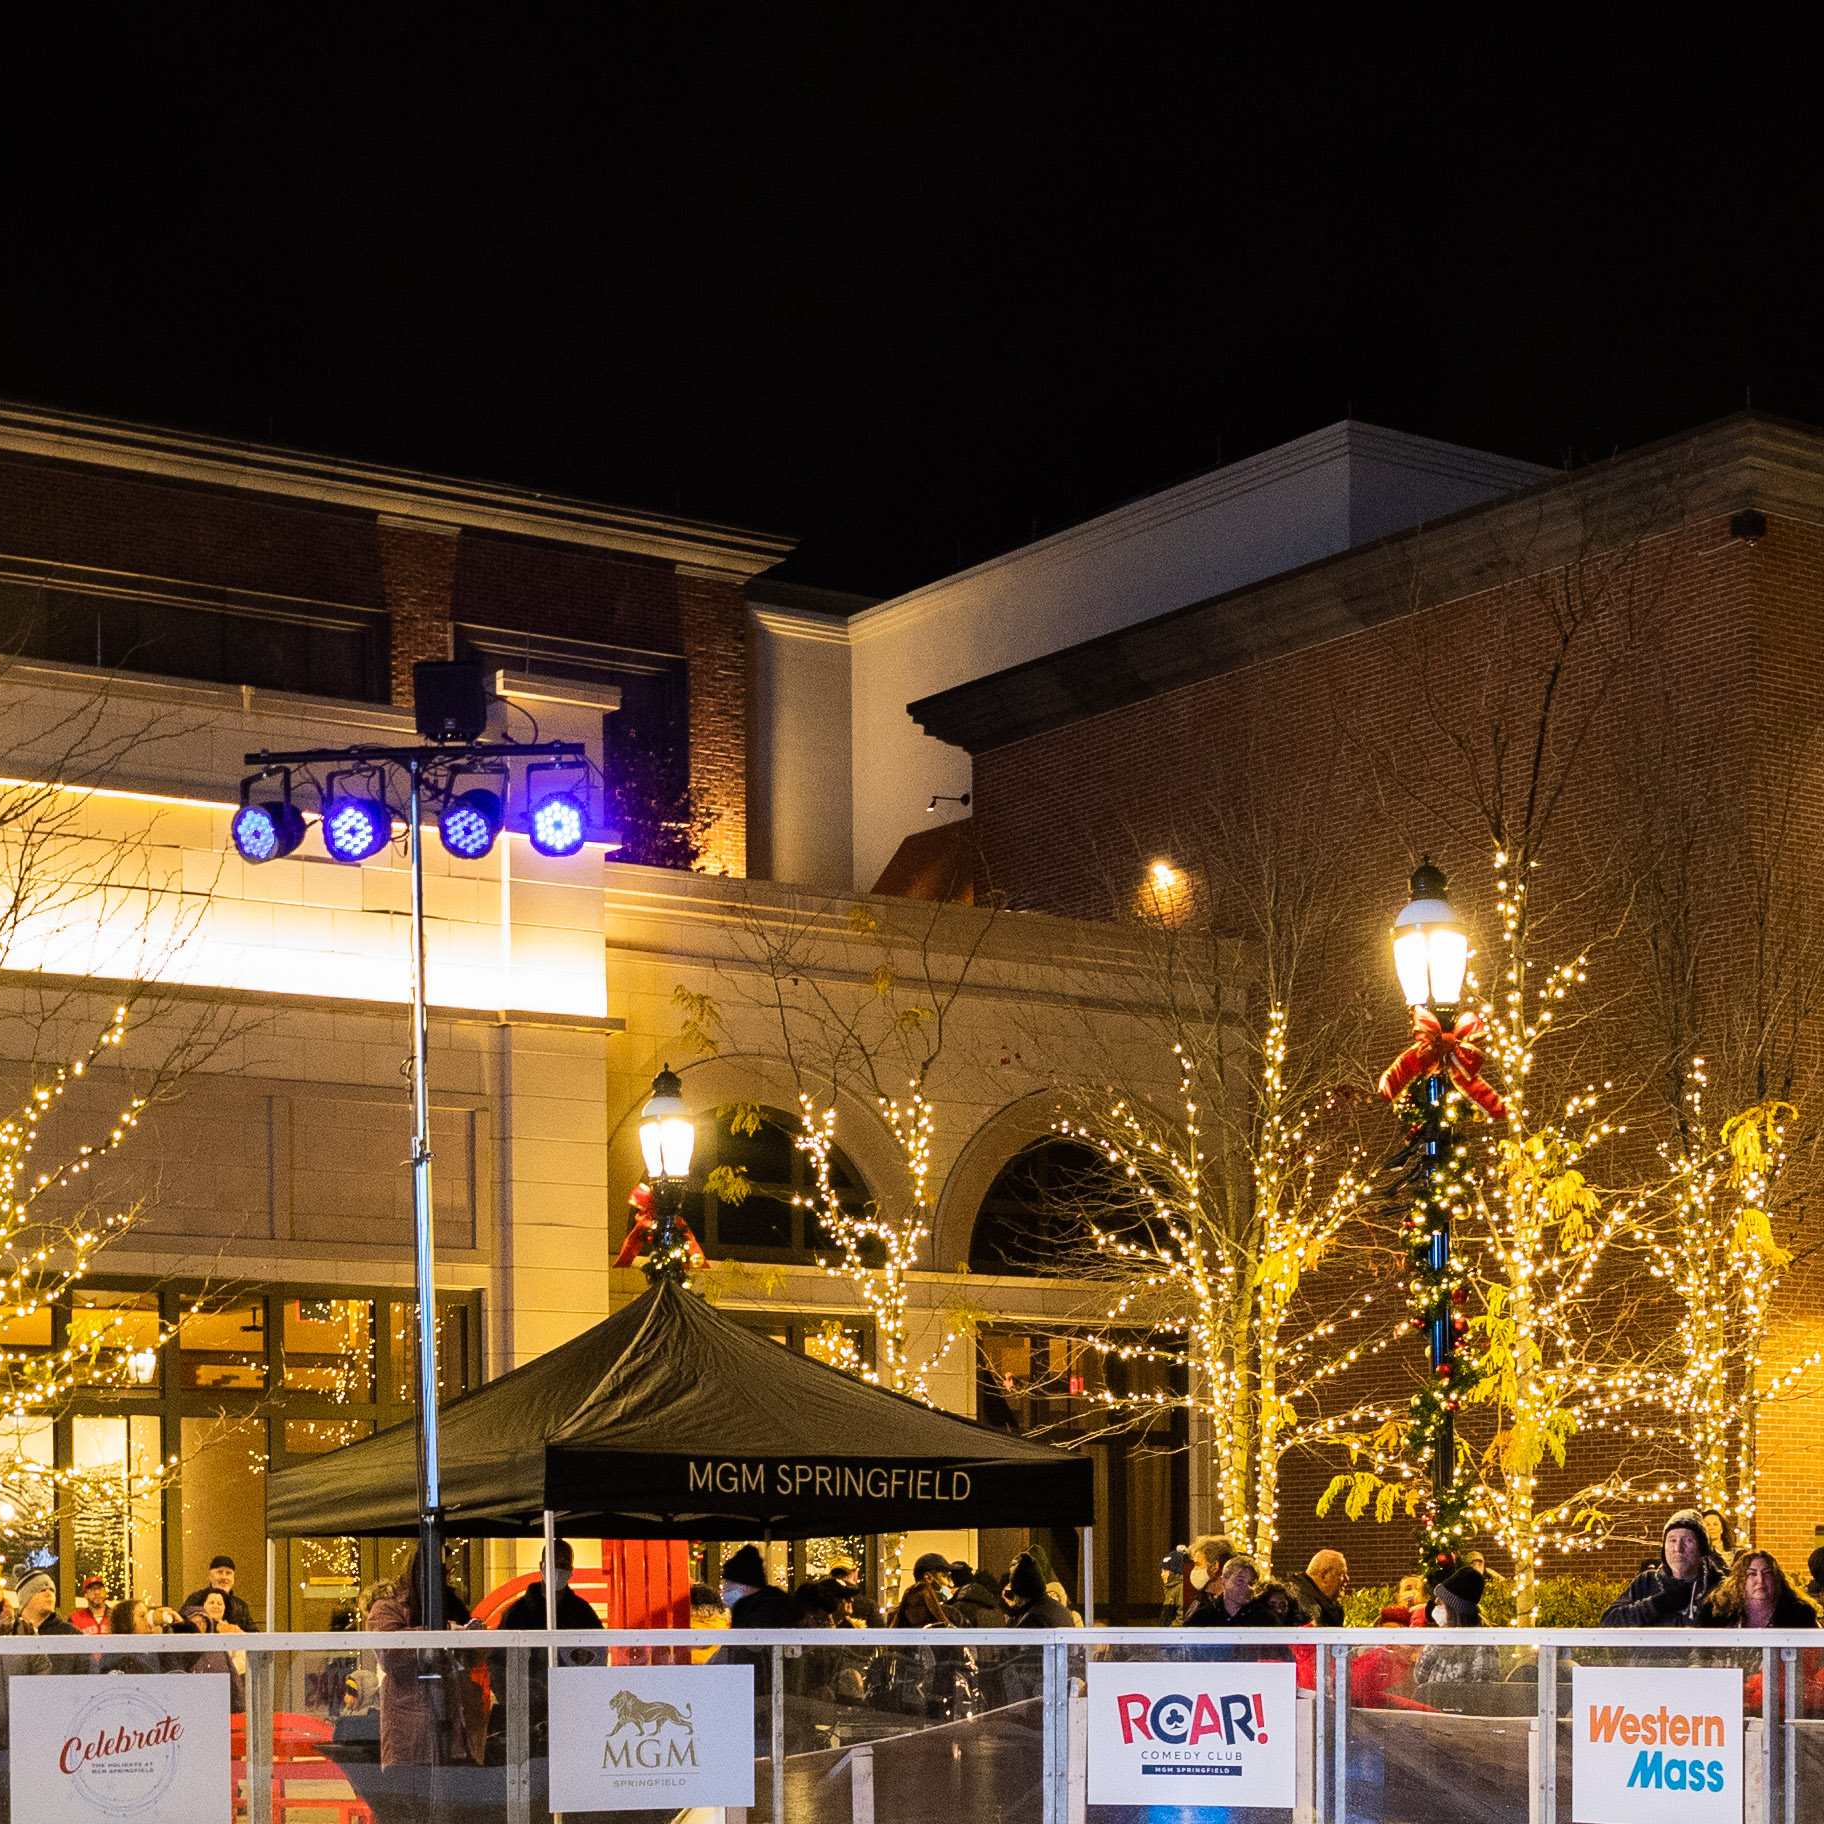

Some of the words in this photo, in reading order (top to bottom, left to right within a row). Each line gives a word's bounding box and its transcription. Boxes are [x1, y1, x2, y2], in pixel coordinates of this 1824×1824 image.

[689, 1462, 765, 1494] MGM
[776, 1464, 971, 1500] SPRINGFIELD
[1117, 1693, 1269, 1745] ROAR!
[1589, 1705, 1725, 1747] Western
[59, 1715, 185, 1774] Celebrate
[602, 1738, 700, 1769] MGM
[1141, 1750, 1200, 1760] COMEDY
[1207, 1751, 1243, 1761] CLUB
[613, 1778, 686, 1788] SPRINGFIELD
[1176, 1766, 1230, 1774] SPRINGFIELD
[1626, 1750, 1725, 1792] Mass
